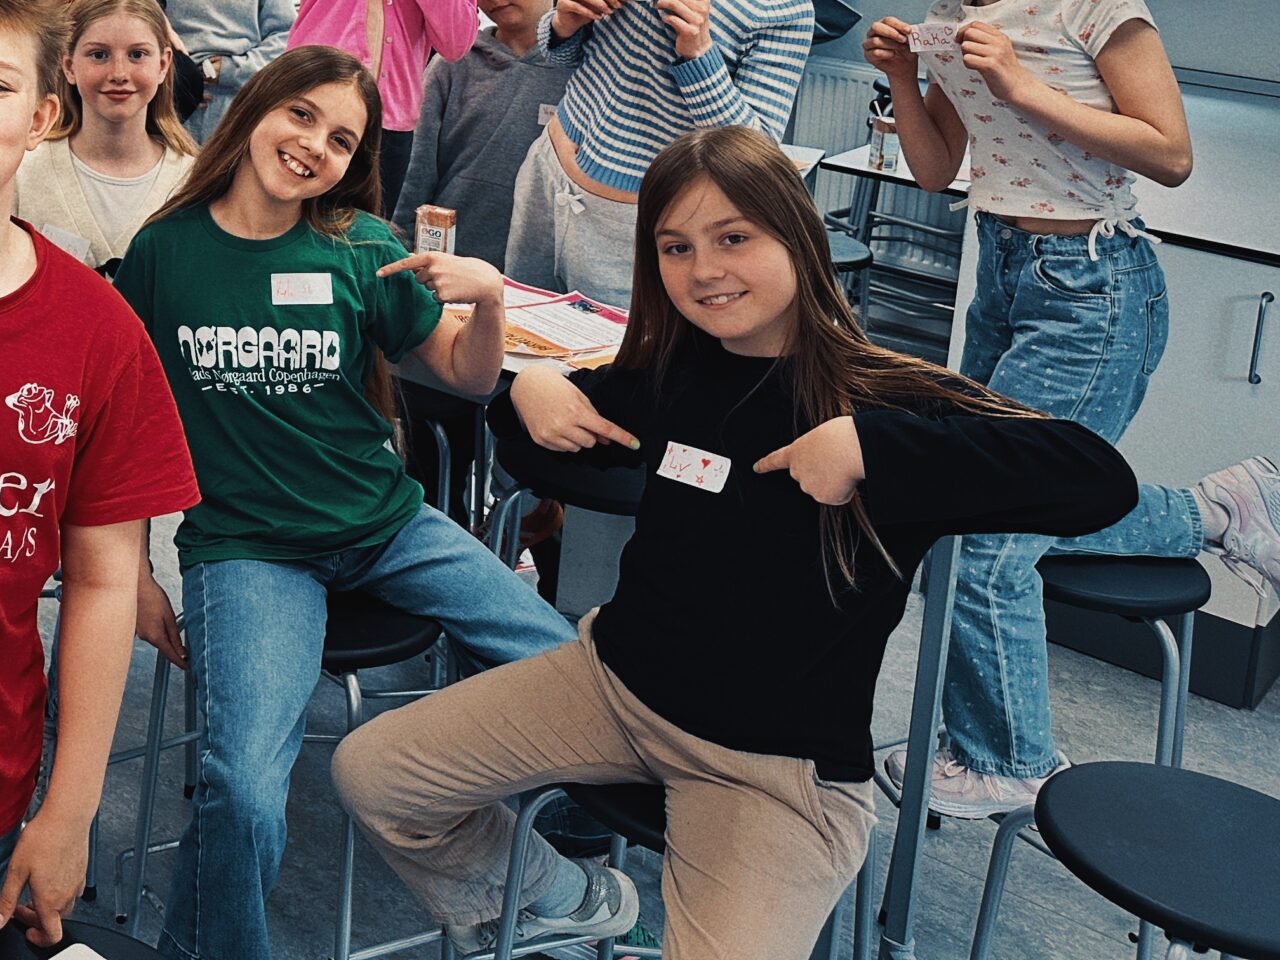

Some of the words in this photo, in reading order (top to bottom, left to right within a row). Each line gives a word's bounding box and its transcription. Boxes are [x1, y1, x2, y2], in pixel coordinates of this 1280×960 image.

[177, 325, 340, 370] NØRGAARD
[190, 368, 211, 381] ads
[212, 368, 265, 385] Nørgaard
[269, 367, 340, 383] Copenhagen
[264, 383, 312, 395] 1986
